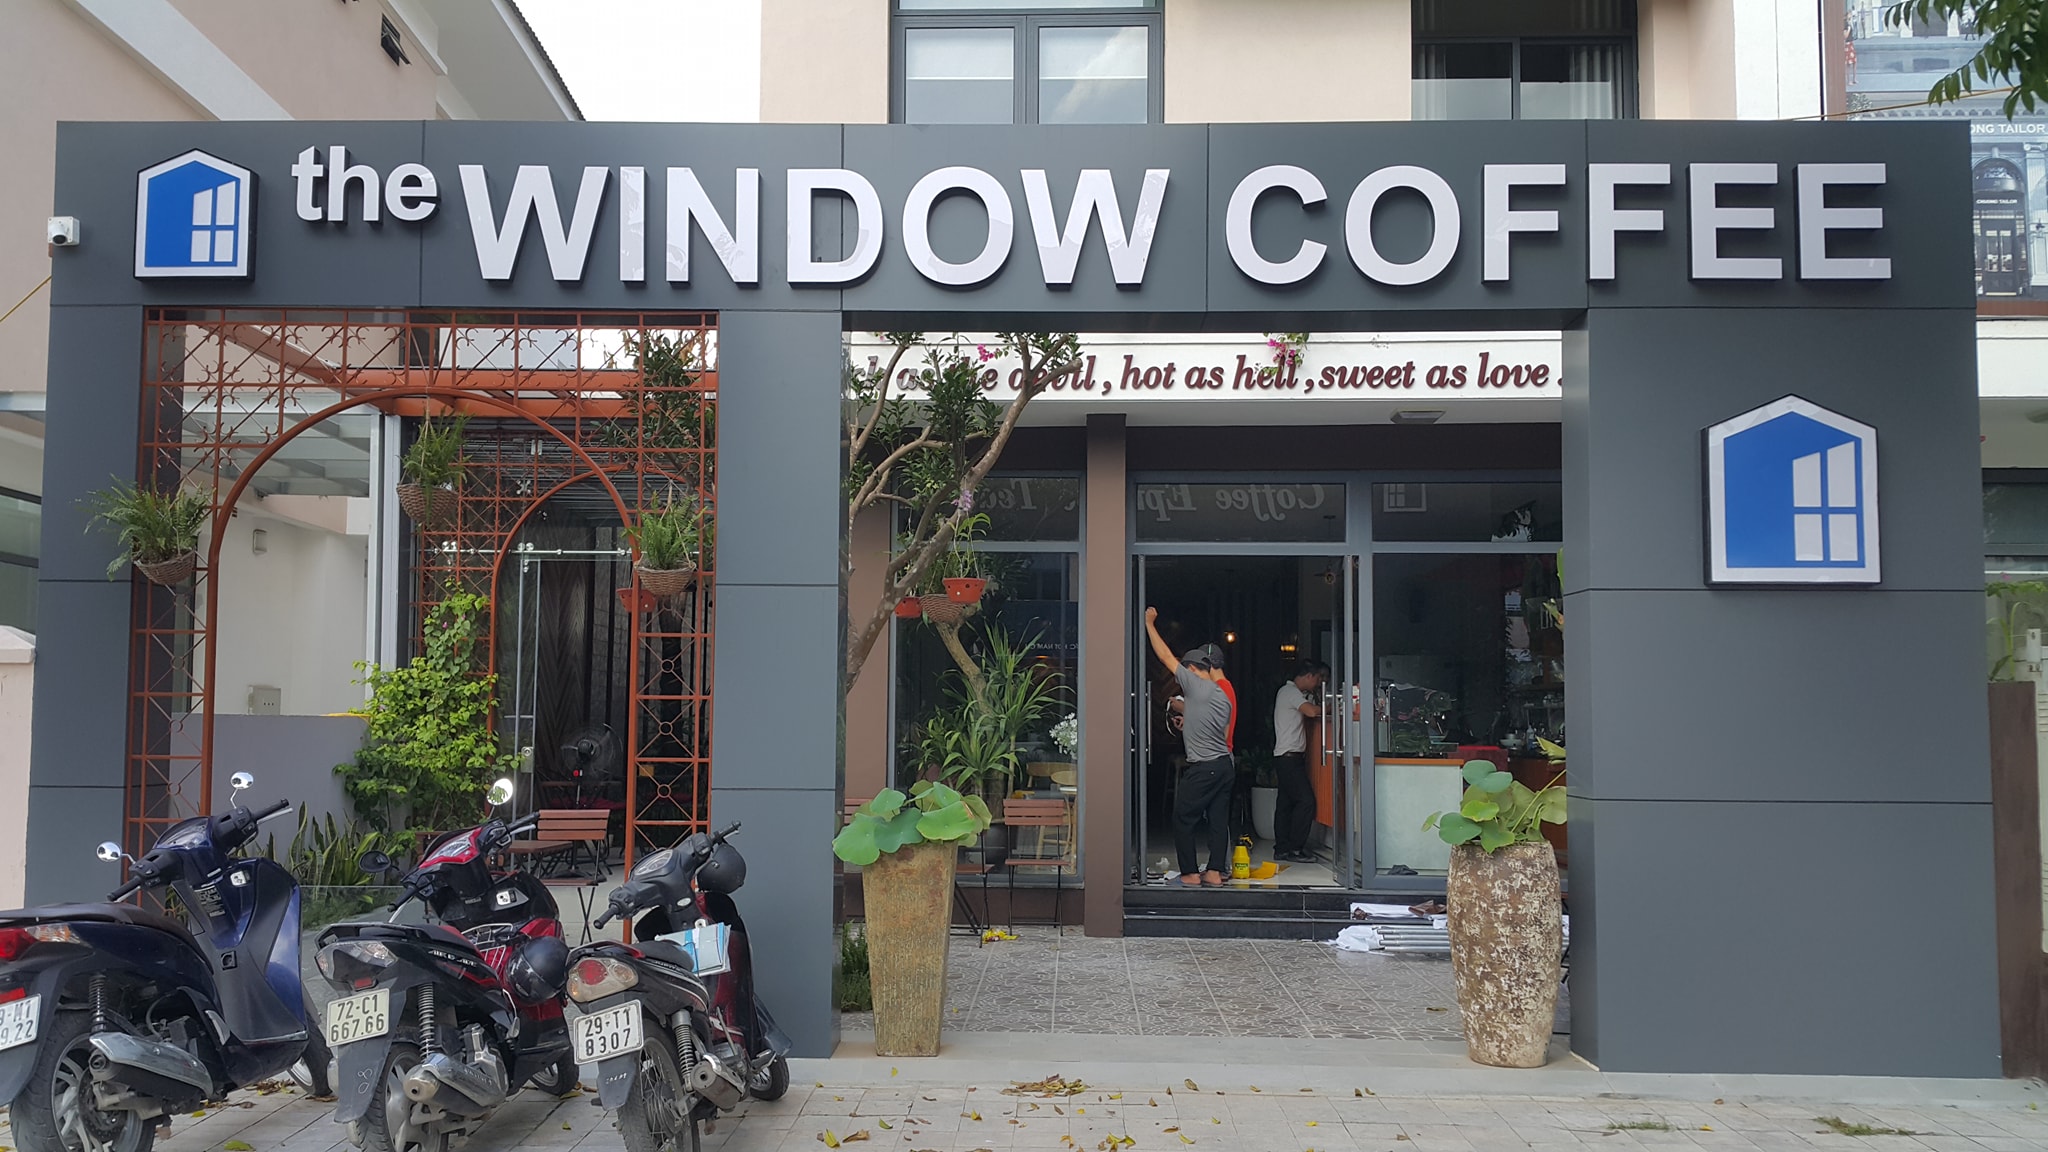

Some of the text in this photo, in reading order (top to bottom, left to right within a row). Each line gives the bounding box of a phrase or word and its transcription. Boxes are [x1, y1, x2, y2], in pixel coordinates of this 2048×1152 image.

[1998, 124, 2045, 133] TAILOR
[291, 146, 1892, 288] the WINDOW COFFEE
[1120, 355, 1176, 390] hot
[1184, 363, 1224, 389] as
[1425, 364, 1468, 388] as
[337, 994, 378, 1021] 72-C1
[331, 1013, 385, 1042] 667.66
[585, 1008, 631, 1037] 29-T1
[585, 1028, 631, 1056] 8307
